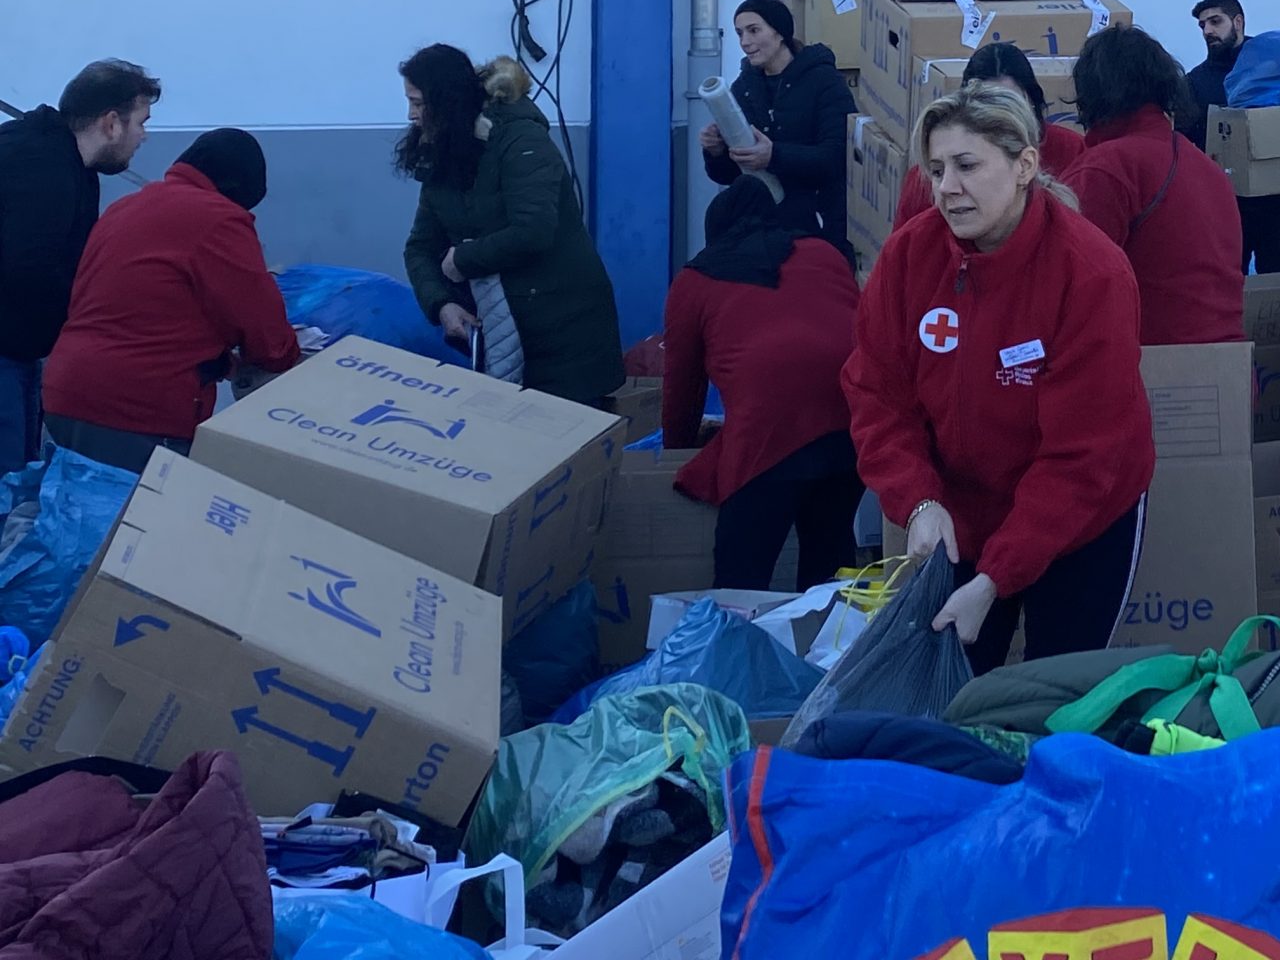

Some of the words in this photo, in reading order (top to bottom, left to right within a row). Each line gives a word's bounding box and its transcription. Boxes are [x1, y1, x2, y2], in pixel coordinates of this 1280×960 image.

[335, 355, 460, 398] öffnen!
[267, 407, 357, 442] Clean
[367, 436, 494, 482] Umzüge
[205, 495, 251, 536] Hier
[400, 577, 447, 640] Umzüge
[1124, 592, 1214, 631] züge
[393, 641, 432, 693] Clean
[18, 654, 85, 752] ACHTUNG:
